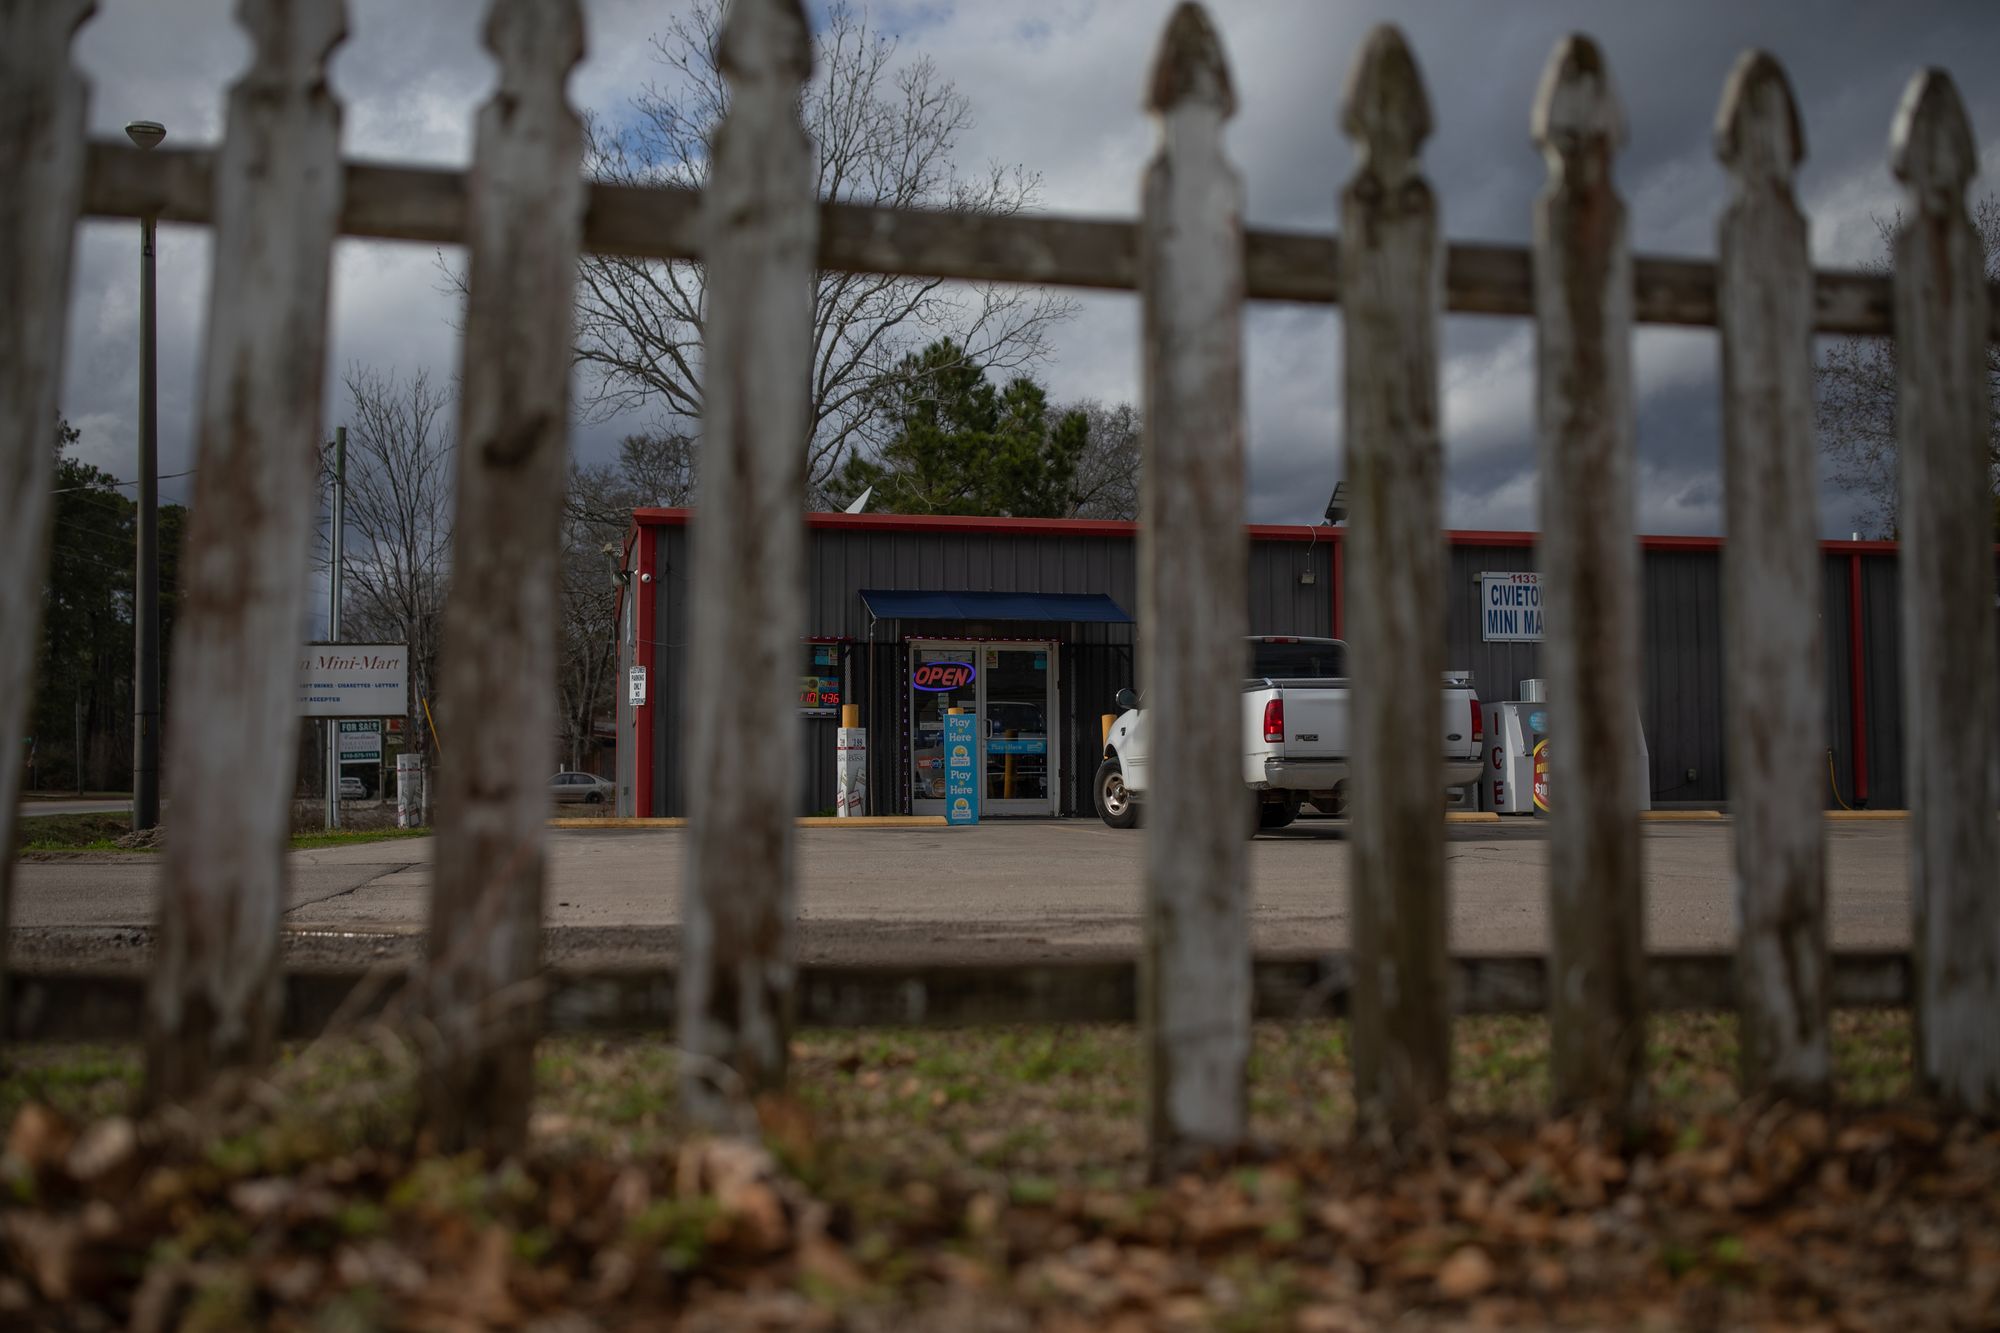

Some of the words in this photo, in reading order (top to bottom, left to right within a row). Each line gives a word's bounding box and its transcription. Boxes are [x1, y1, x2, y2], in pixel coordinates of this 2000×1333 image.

[1510, 574, 1537, 583] 1133
[1488, 610, 1518, 634] MINI
[1524, 610, 1544, 634] MA
[316, 656, 399, 670] Mini-Mart
[915, 666, 969, 686] OPEN
[821, 693, 839, 703] 436
[342, 723, 357, 731] FOR
[358, 722, 377, 731] SALE
[950, 718, 970, 728] Play
[949, 733, 972, 742] Here
[1492, 712, 1504, 805] ICE
[951, 770, 971, 781] Play
[950, 785, 973, 794] Here
